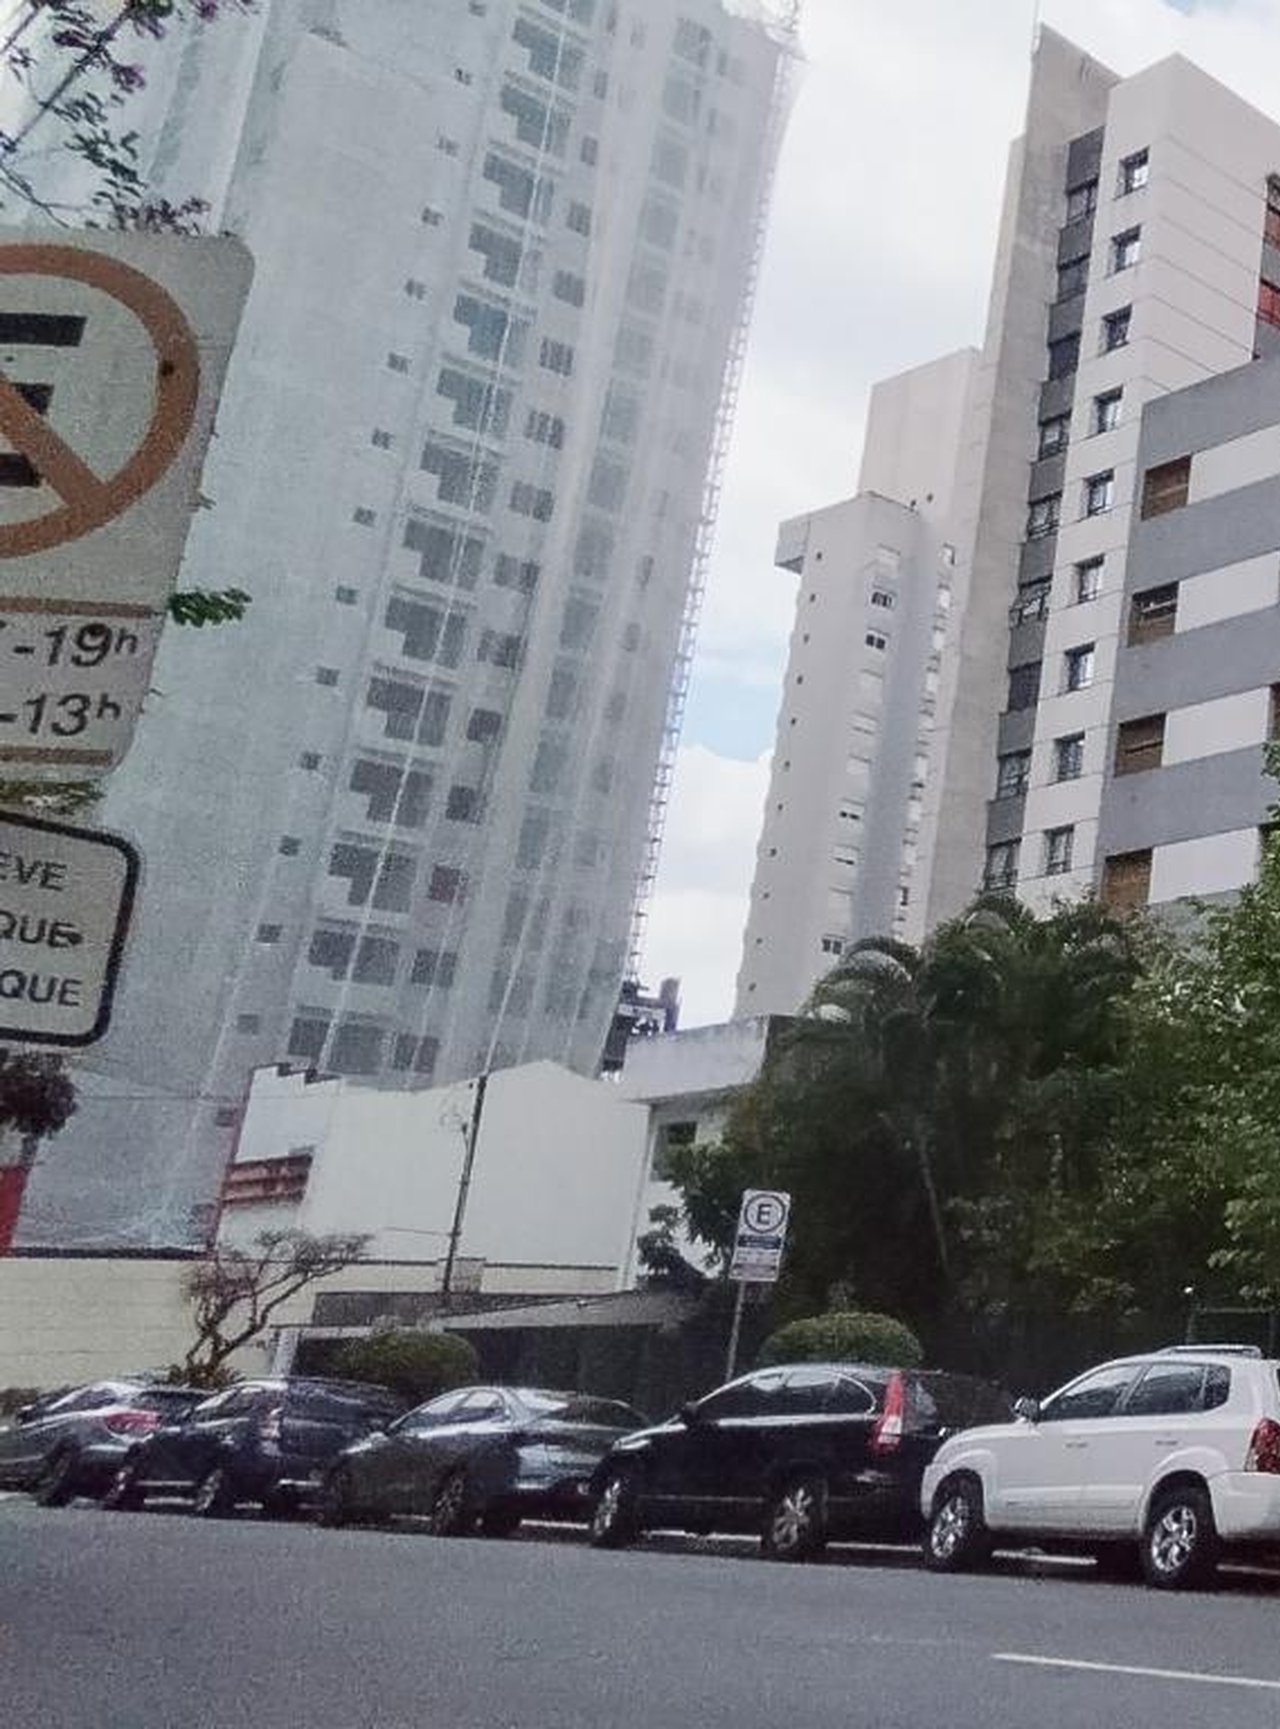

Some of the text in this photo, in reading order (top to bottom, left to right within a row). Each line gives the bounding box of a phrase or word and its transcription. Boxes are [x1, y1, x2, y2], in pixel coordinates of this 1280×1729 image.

[0, 620, 139, 668] -19h
[0, 968, 83, 1007] QUE
[757, 1203, 773, 1226] E
